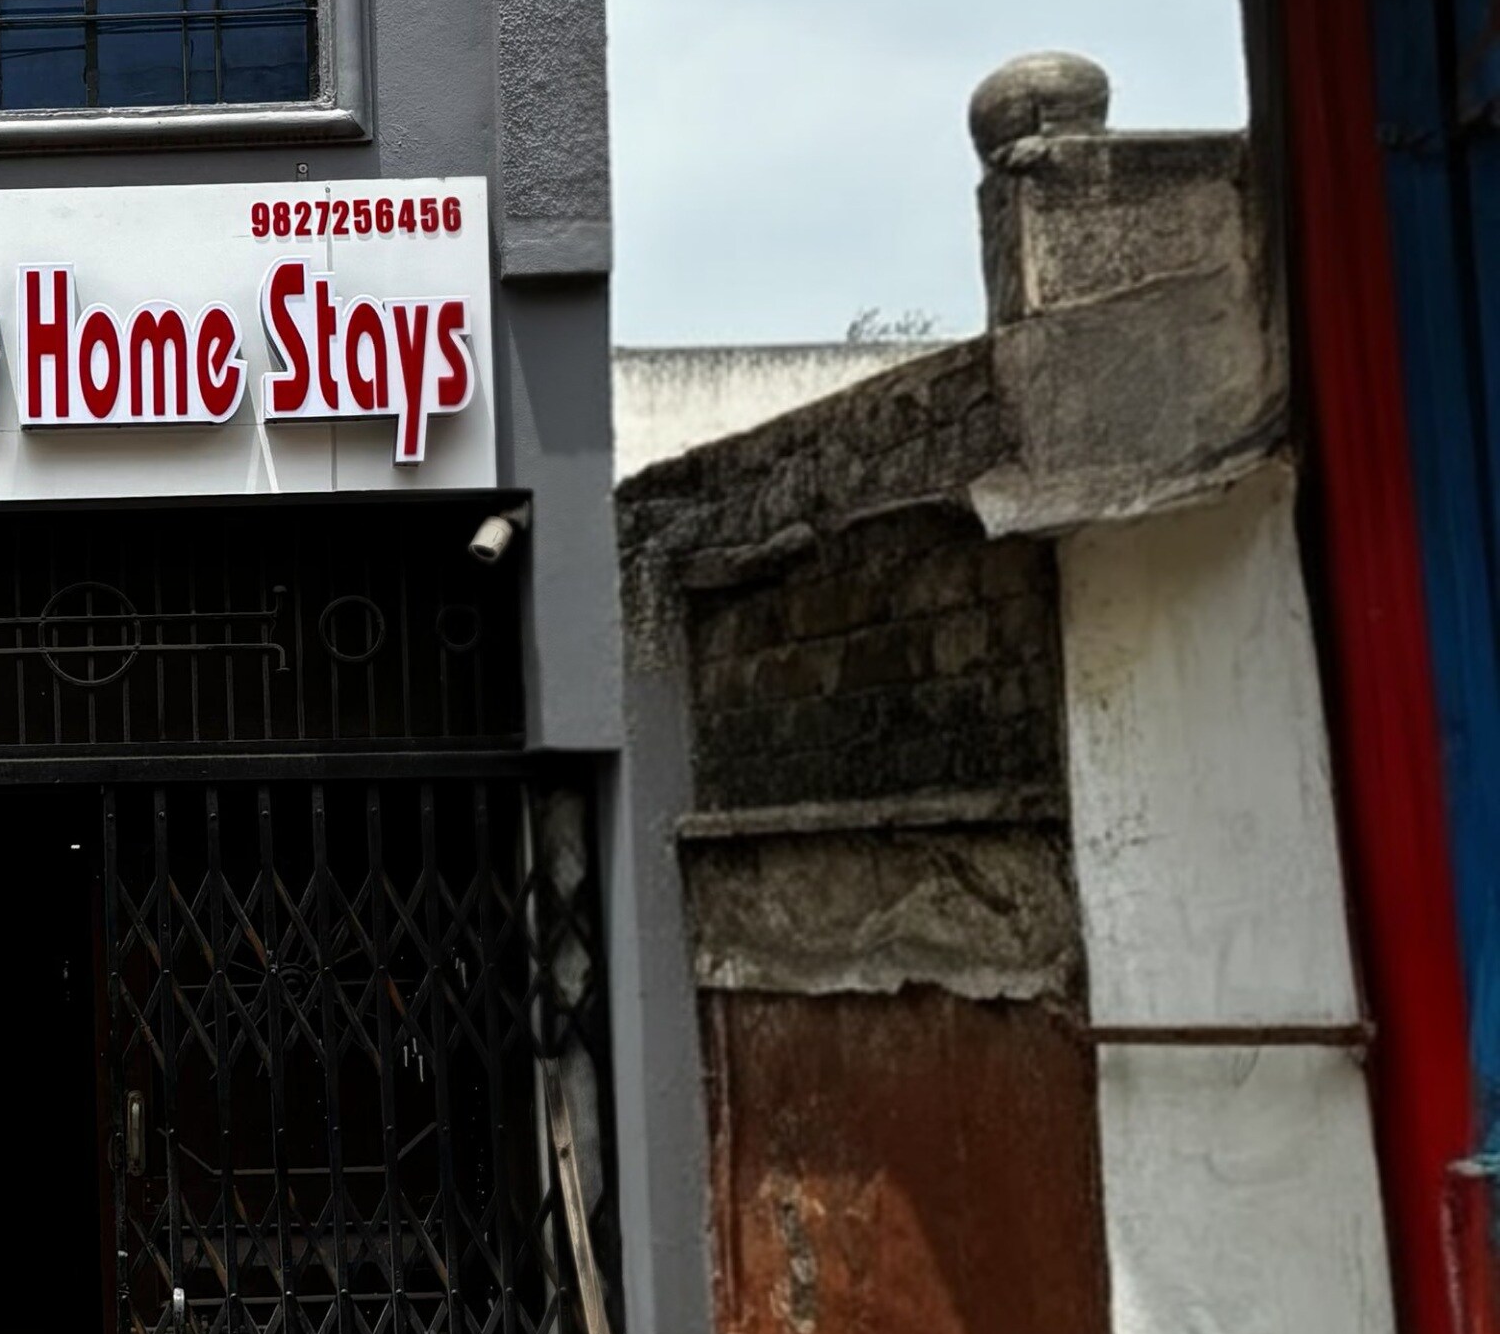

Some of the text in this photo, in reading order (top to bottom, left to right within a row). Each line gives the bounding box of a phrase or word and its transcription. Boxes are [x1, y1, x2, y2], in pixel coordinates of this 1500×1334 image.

[252, 198, 460, 237] 9827256456
[27, 271, 238, 417] Home
[270, 264, 466, 454] Stays
